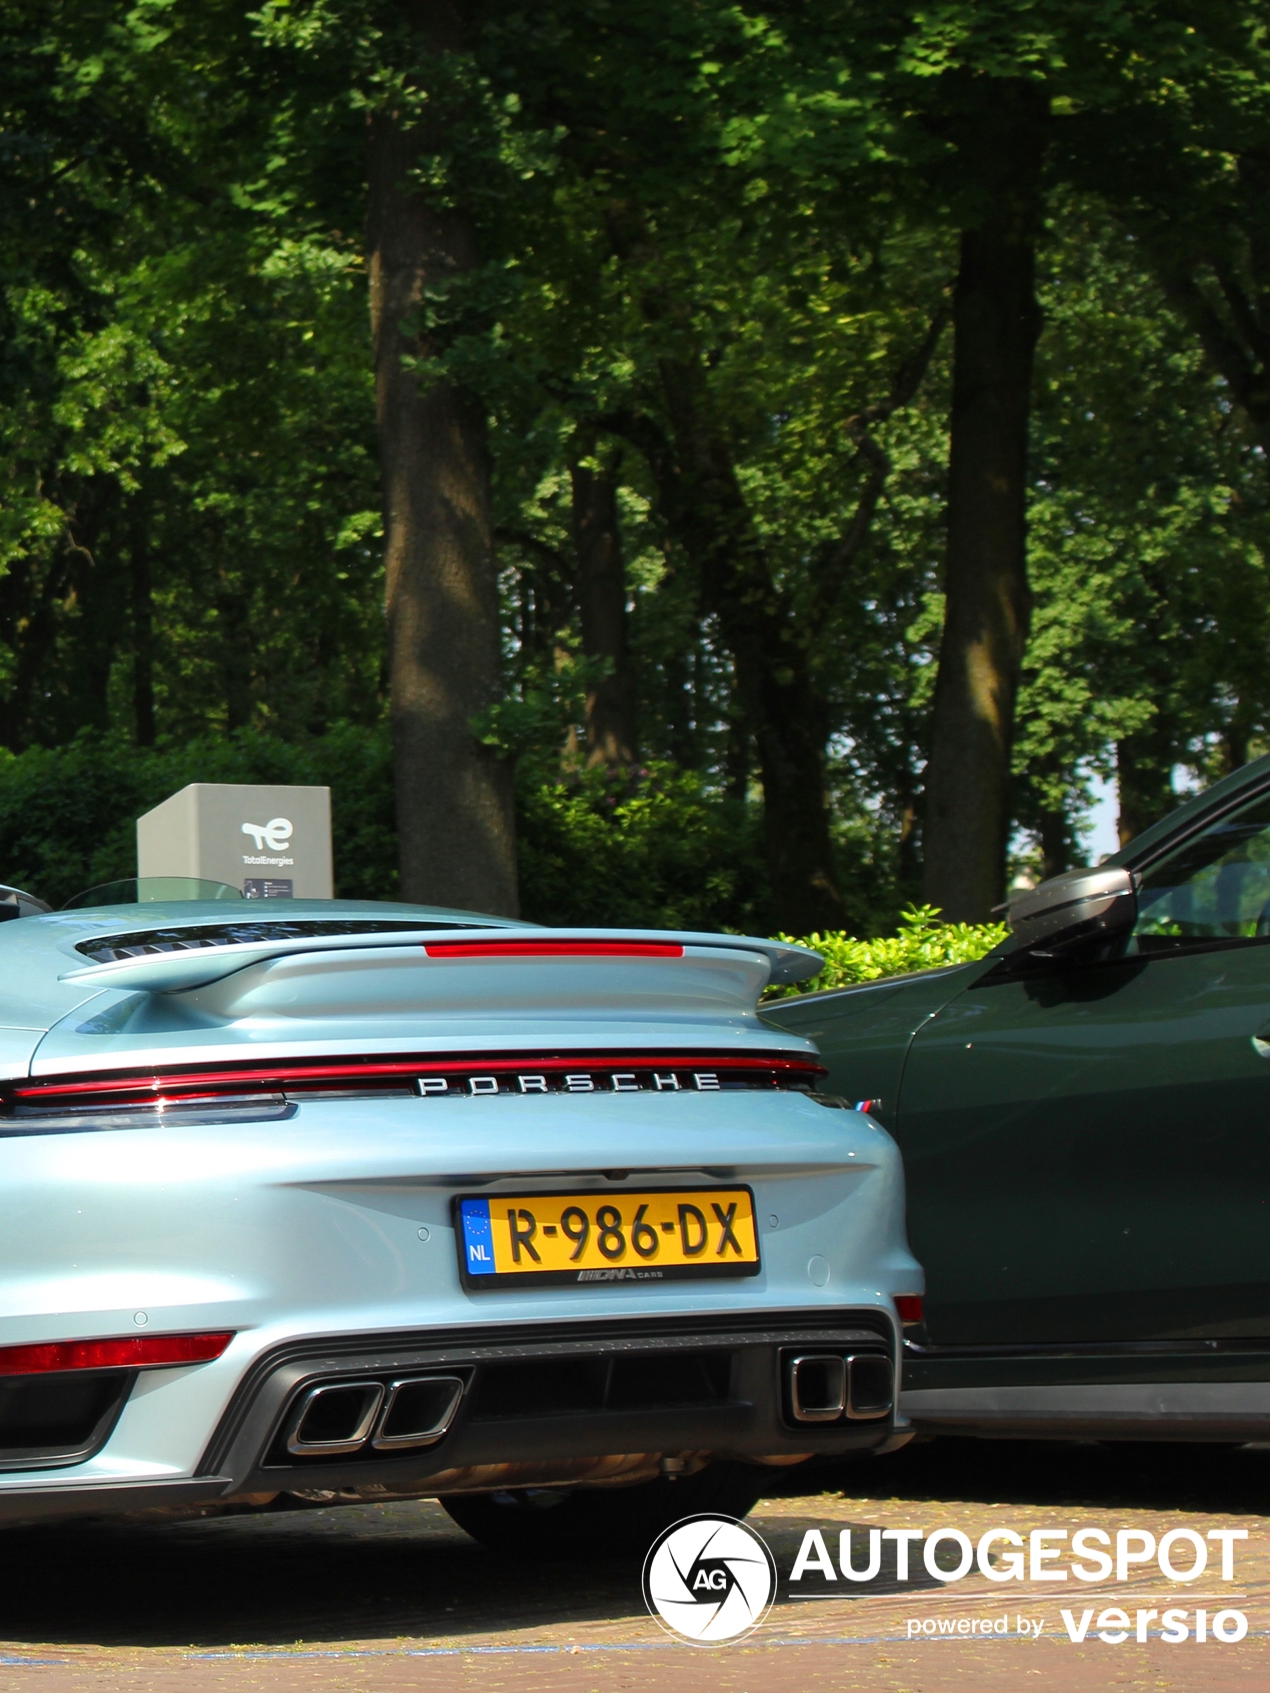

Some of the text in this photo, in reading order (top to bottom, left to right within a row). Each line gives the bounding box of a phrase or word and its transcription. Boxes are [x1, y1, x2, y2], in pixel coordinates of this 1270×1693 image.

[242, 855, 294, 867] TotalEnergies
[417, 1072, 720, 1096] PORSCHE
[507, 1202, 743, 1263] R-986-DX
[469, 1244, 491, 1262] NL
[637, 1271, 664, 1279] CARS
